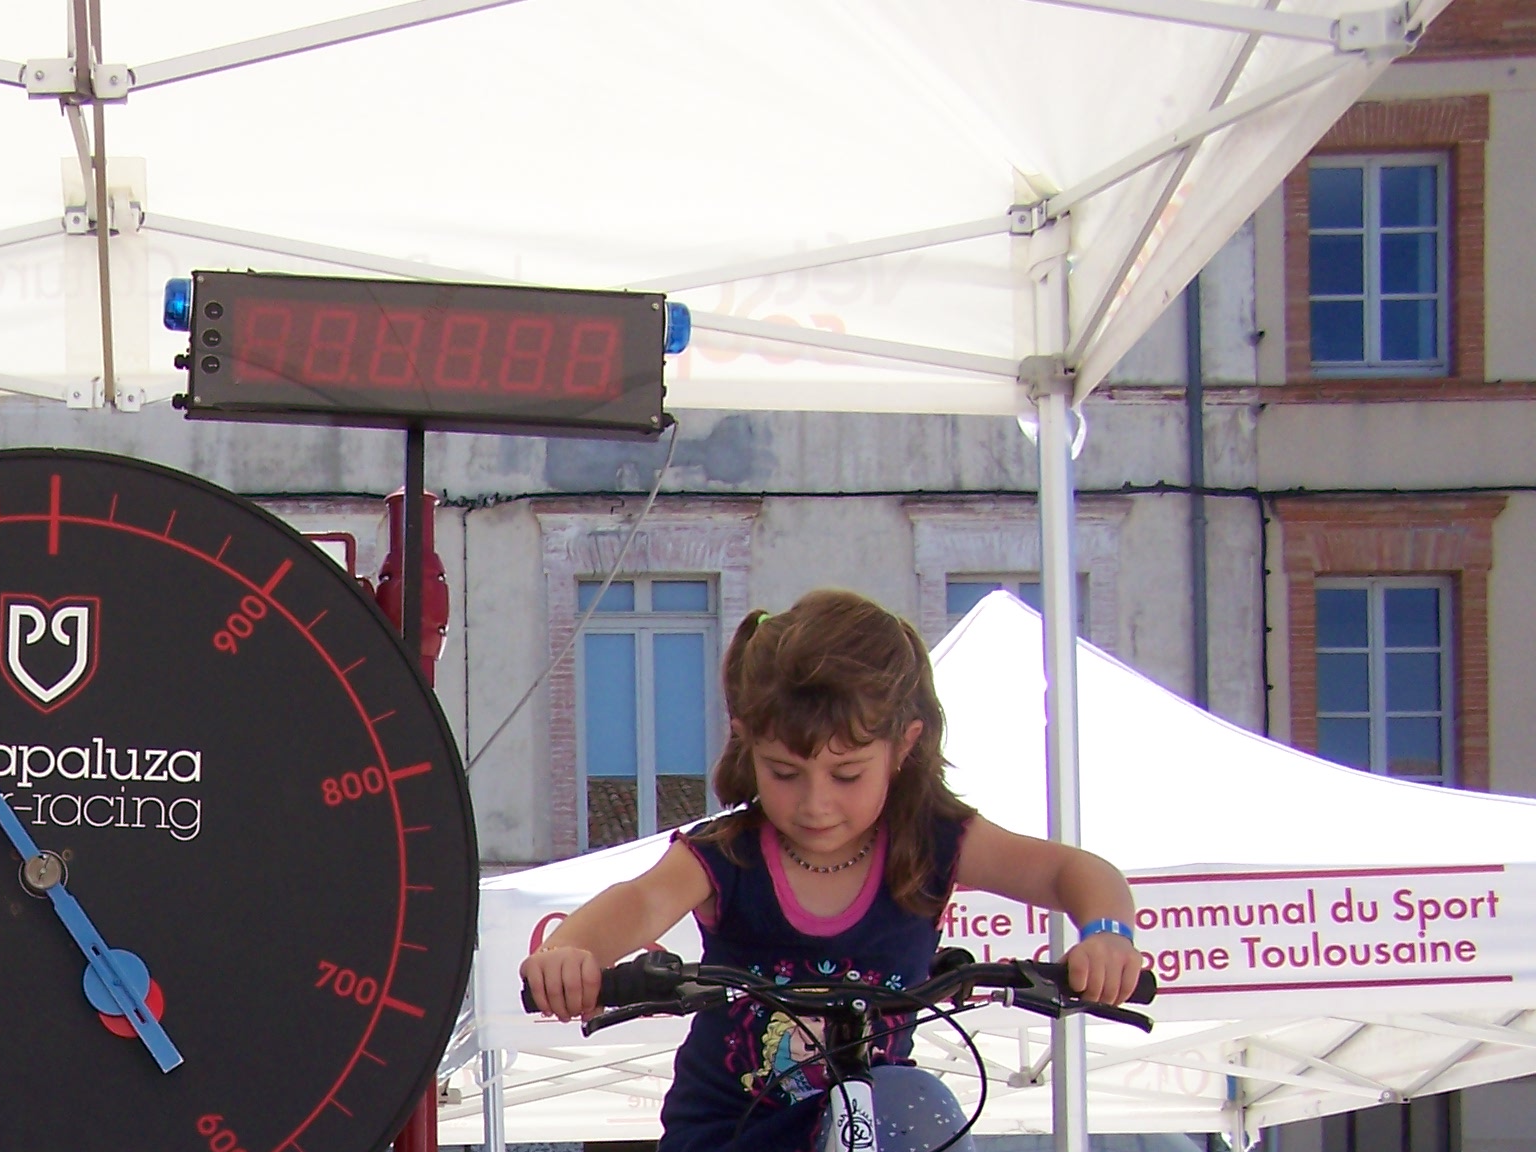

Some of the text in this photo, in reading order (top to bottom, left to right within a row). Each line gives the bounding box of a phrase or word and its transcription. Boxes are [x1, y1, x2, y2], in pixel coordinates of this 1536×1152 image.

[213, 595, 268, 655] 900
[321, 766, 385, 807] 800
[1329, 887, 1385, 924] du
[1392, 888, 1500, 934] Sport
[1240, 931, 1478, 970] Toulousaine
[315, 959, 379, 1004] 700
